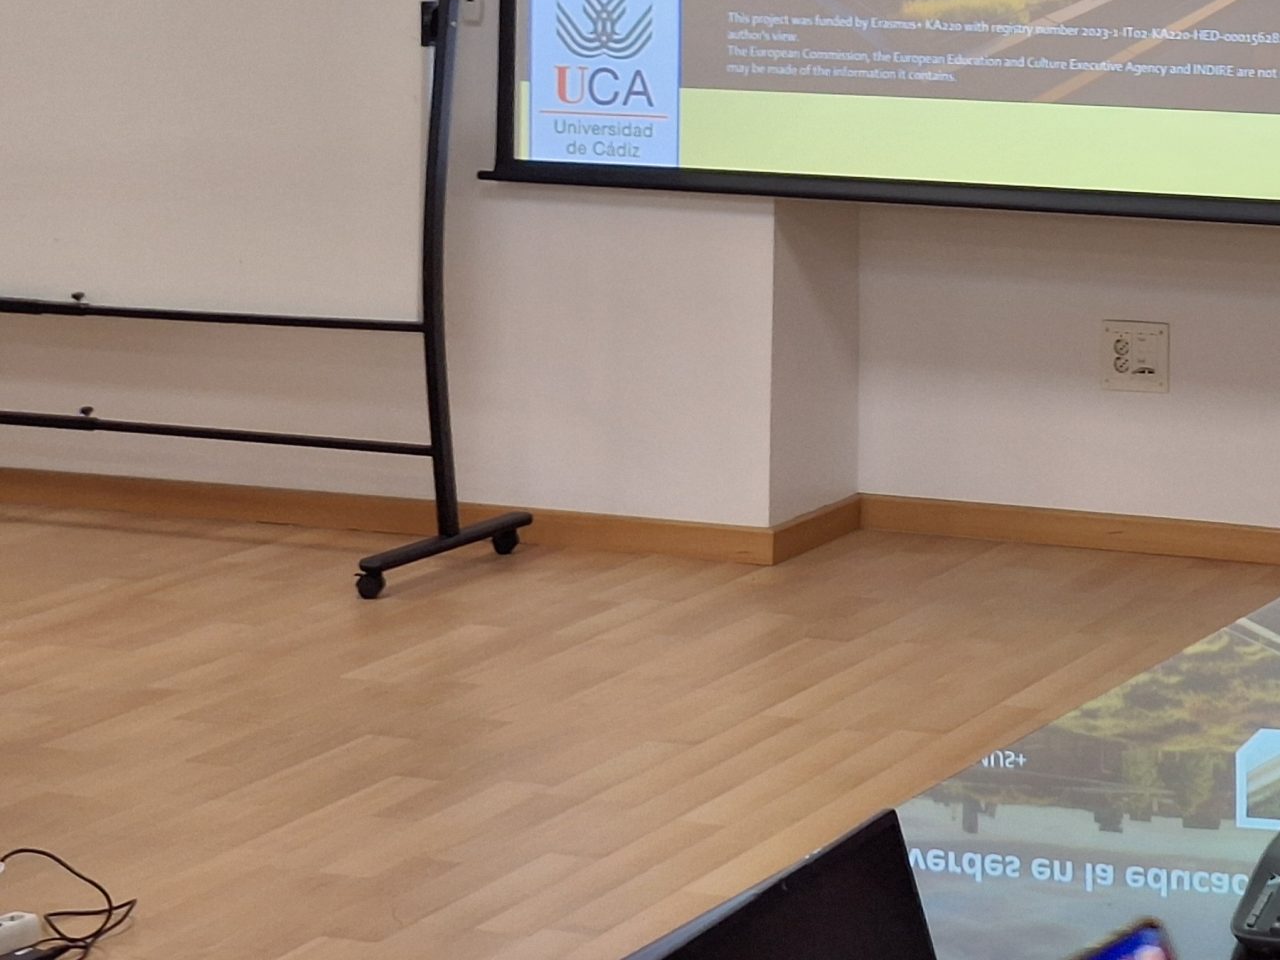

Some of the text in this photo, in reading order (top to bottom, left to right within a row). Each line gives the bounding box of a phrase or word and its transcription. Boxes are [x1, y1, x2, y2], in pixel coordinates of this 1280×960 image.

[728, 12, 749, 24] This
[752, 15, 789, 28] project
[792, 17, 813, 26] was
[815, 15, 853, 28] funded
[855, 17, 869, 30] by
[925, 19, 961, 31] KA220
[965, 20, 989, 32] with
[991, 21, 1033, 37] registry
[1036, 24, 1079, 36] number
[727, 63, 748, 76] may
[752, 63, 766, 74] be
[767, 64, 797, 75] made
[801, 65, 812, 76] of
[812, 65, 831, 77] the
[833, 66, 896, 80] information
[898, 70, 907, 80] it
[728, 45, 748, 57] The
[750, 46, 800, 60] European
[802, 48, 870, 63] Commission,
[873, 51, 891, 62] the
[893, 52, 945, 66] European
[947, 53, 1000, 66] Education
[1004, 56, 1025, 68] and
[1027, 57, 1066, 69] Culture
[1069, 59, 1123, 72] Executive
[1125, 62, 1167, 77] Agency
[1169, 63, 1191, 75] and
[1193, 64, 1234, 77] INDIRE
[1236, 68, 1255, 78] are
[1257, 68, 1276, 79] not
[554, 65, 655, 108] UCA
[554, 120, 653, 138] Universidad
[566, 141, 640, 158] de Cádiz
